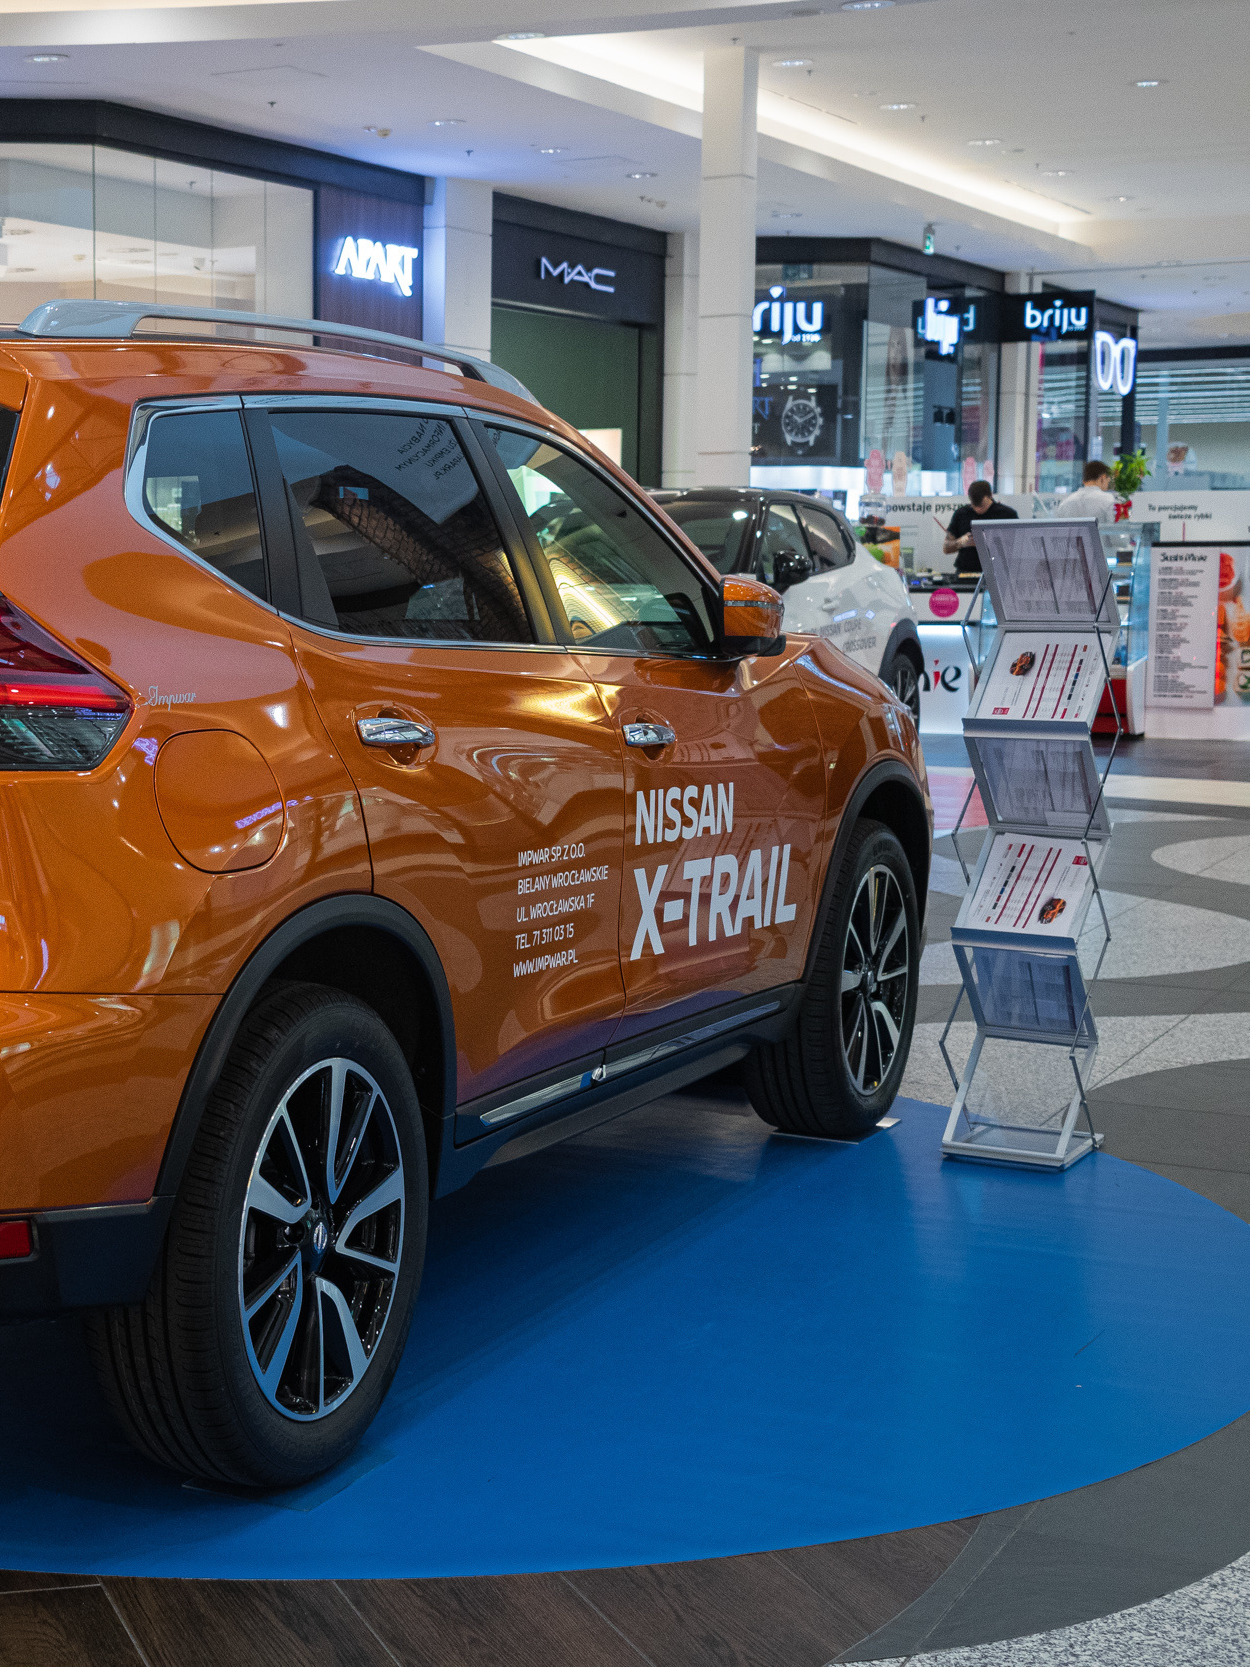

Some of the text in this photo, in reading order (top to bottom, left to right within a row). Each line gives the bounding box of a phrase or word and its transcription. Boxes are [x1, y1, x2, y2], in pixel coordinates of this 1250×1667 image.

[334, 236, 419, 297] APART
[752, 285, 824, 345] riju
[1024, 299, 1089, 335] briju
[635, 782, 734, 846] NISSAN
[518, 842, 586, 868] IMPWAR SP. Z O.O.
[517, 865, 609, 895] BIELANY WROCŁAWSKIE
[516, 893, 595, 923] UL. WROCŁAWSKA 1F
[630, 843, 797, 962] X-TRAIL
[533, 930, 540, 946] 71
[541, 927, 553, 944] 311
[554, 925, 565, 941] 03
[566, 923, 575, 939] 15
[513, 949, 579, 978] WWW.IMPWAR.PL
